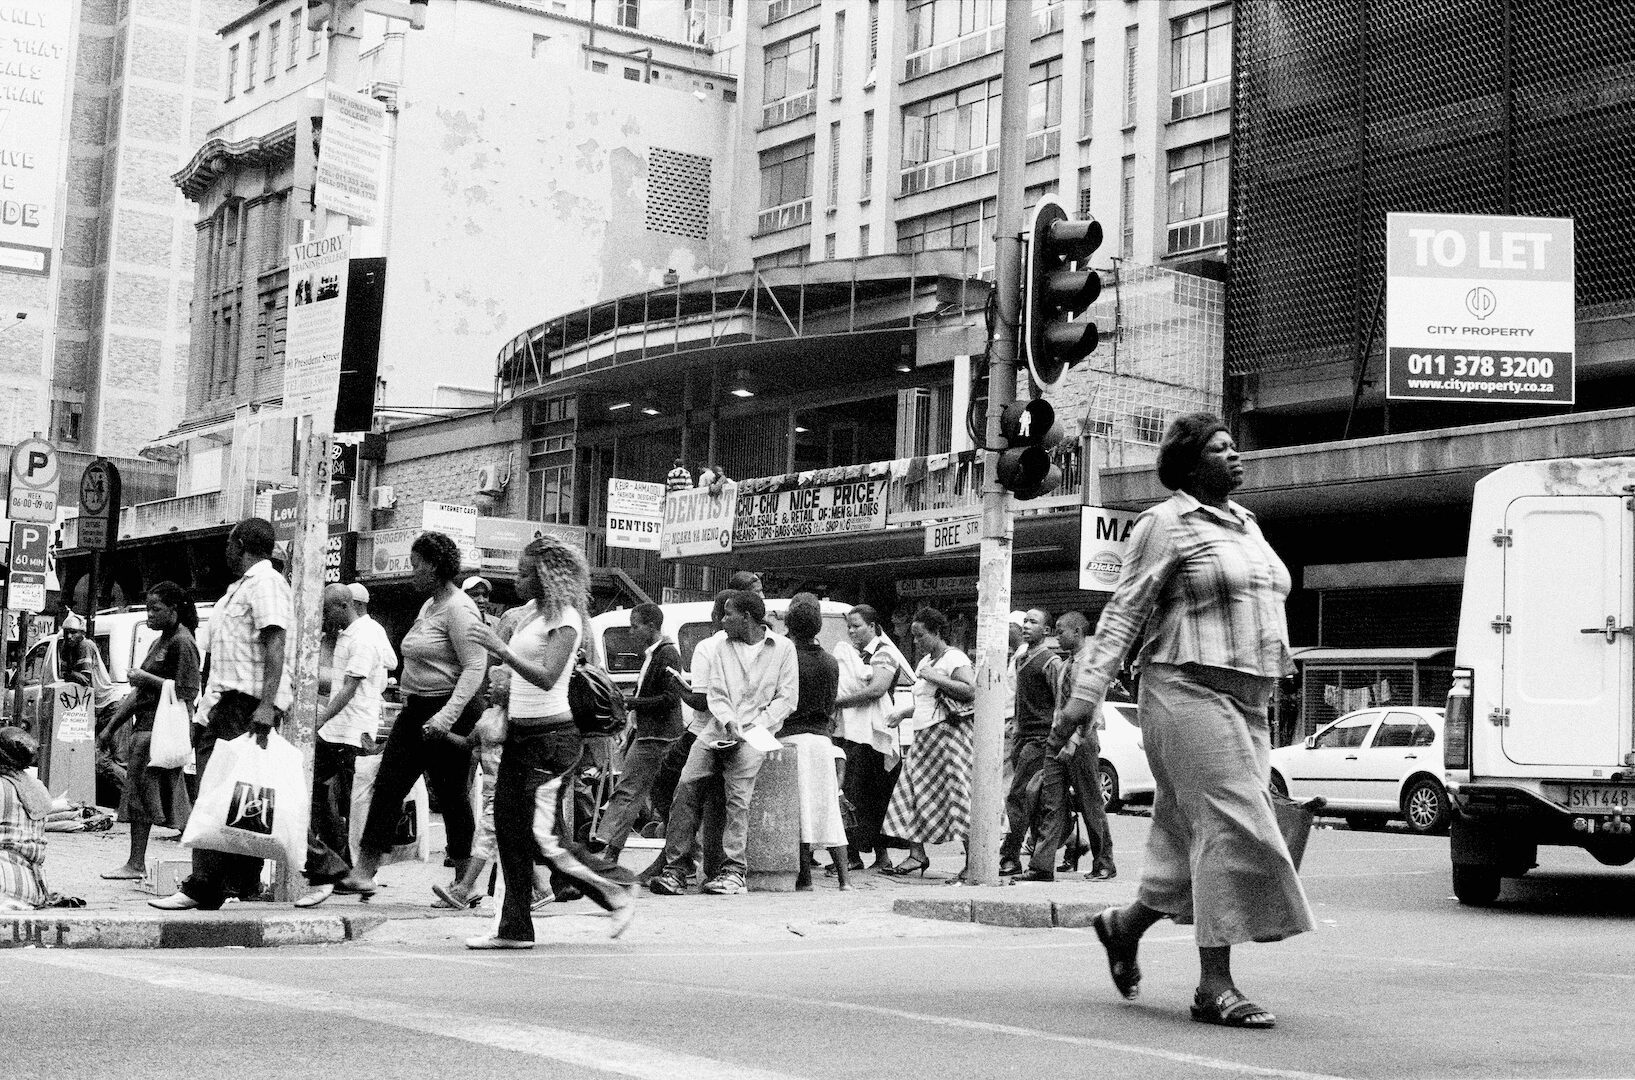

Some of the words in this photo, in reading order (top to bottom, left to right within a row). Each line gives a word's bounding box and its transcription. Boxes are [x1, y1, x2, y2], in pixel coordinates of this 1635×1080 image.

[0, 62, 41, 80] ALS
[340, 106, 369, 123] COLLEGE
[0, 149, 34, 169] IVE
[0, 200, 40, 228] DE
[294, 234, 345, 260] VICTORY
[1408, 229, 1466, 267] TO
[1478, 231, 1552, 270] LET
[1427, 325, 1458, 335] CITY
[1462, 326, 1535, 337] PROPERTY
[1408, 354, 1446, 375] 011
[1453, 355, 1495, 377] 378
[1500, 357, 1554, 378] 3200
[1407, 378, 1554, 394] www.cityproperty.co.za
[28, 451, 48, 477] P
[440, 504, 463, 515] INTERNET
[666, 489, 735, 525] DENTIST
[737, 494, 780, 517] CHU-CHU
[789, 488, 821, 511] NICE
[833, 481, 887, 506] PRICE!
[610, 518, 662, 534] DENTIST
[737, 512, 778, 530] WHOLESALE
[781, 511, 789, 524] &
[790, 509, 814, 524] RETAIL
[853, 502, 879, 517] LADIES
[22, 528, 40, 549] P
[934, 524, 961, 548] BREE
[966, 520, 979, 535] STR
[15, 554, 28, 566] 60
[29, 556, 44, 567] MIN
[1089, 562, 1121, 573] Dickie
